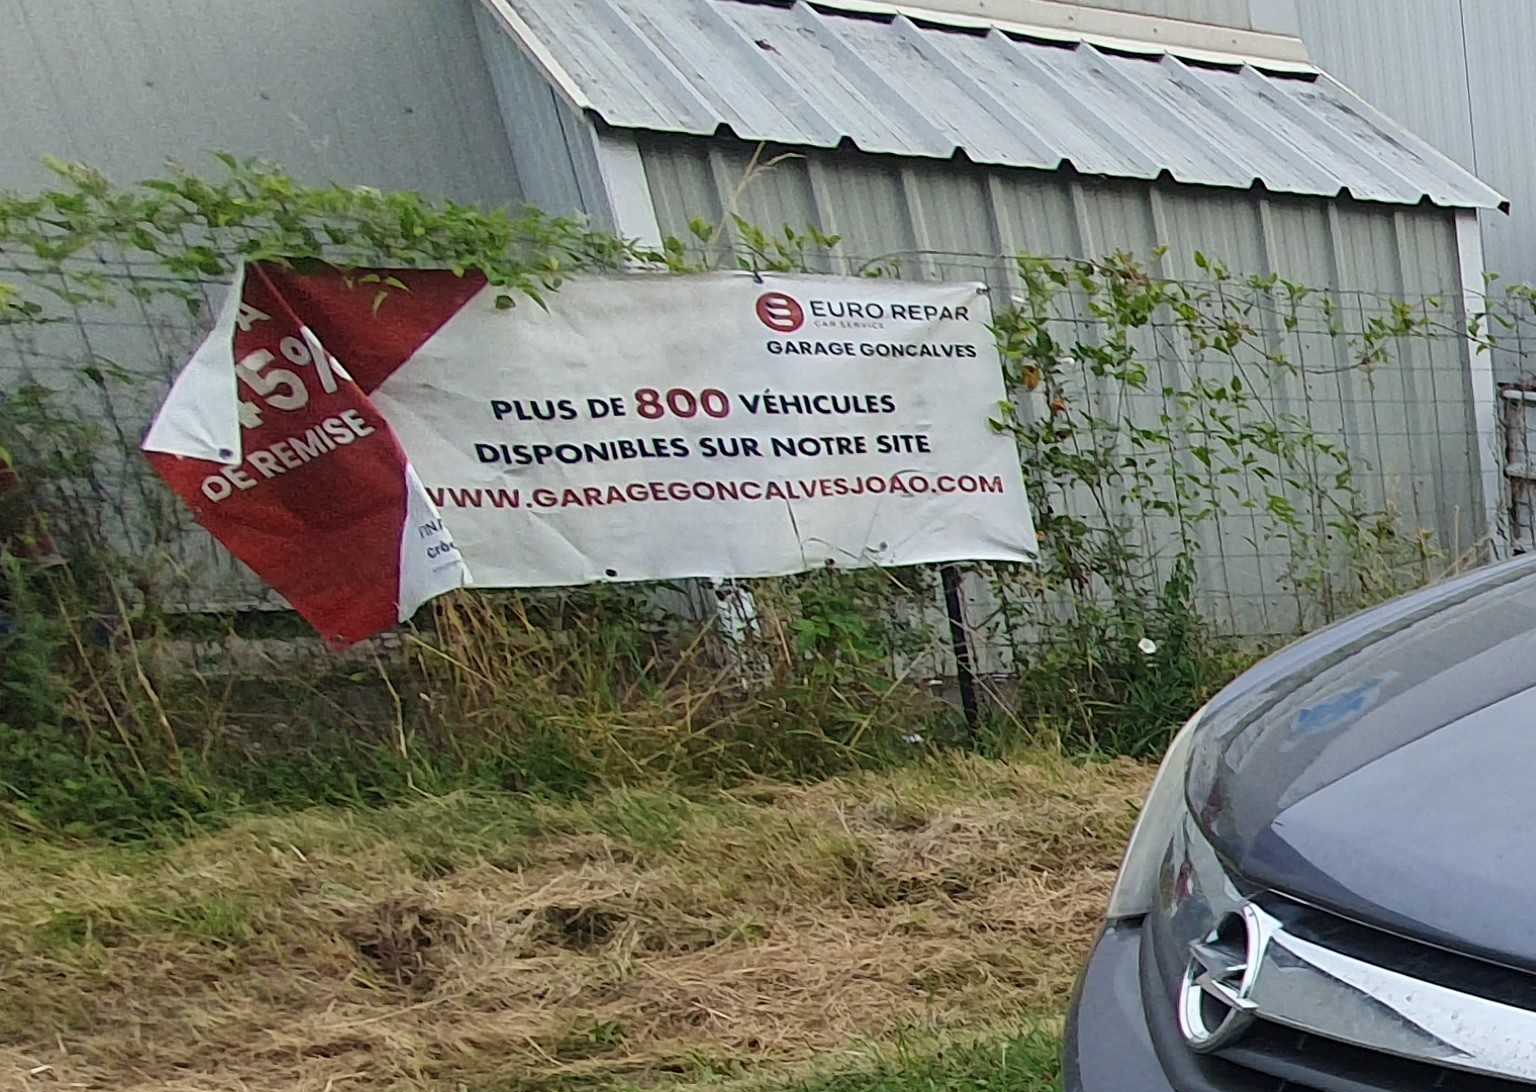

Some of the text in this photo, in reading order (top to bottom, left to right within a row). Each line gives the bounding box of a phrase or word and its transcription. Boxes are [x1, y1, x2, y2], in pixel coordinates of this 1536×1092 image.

[809, 300, 969, 321] EURO REPAR
[766, 341, 977, 358] GARAGE GONCALVES
[491, 388, 896, 421] PLUS DE 800 VÉHICULES
[202, 409, 376, 503] DE REMISE
[473, 434, 932, 465] DISPONIBLES SUR NOTRE SITE
